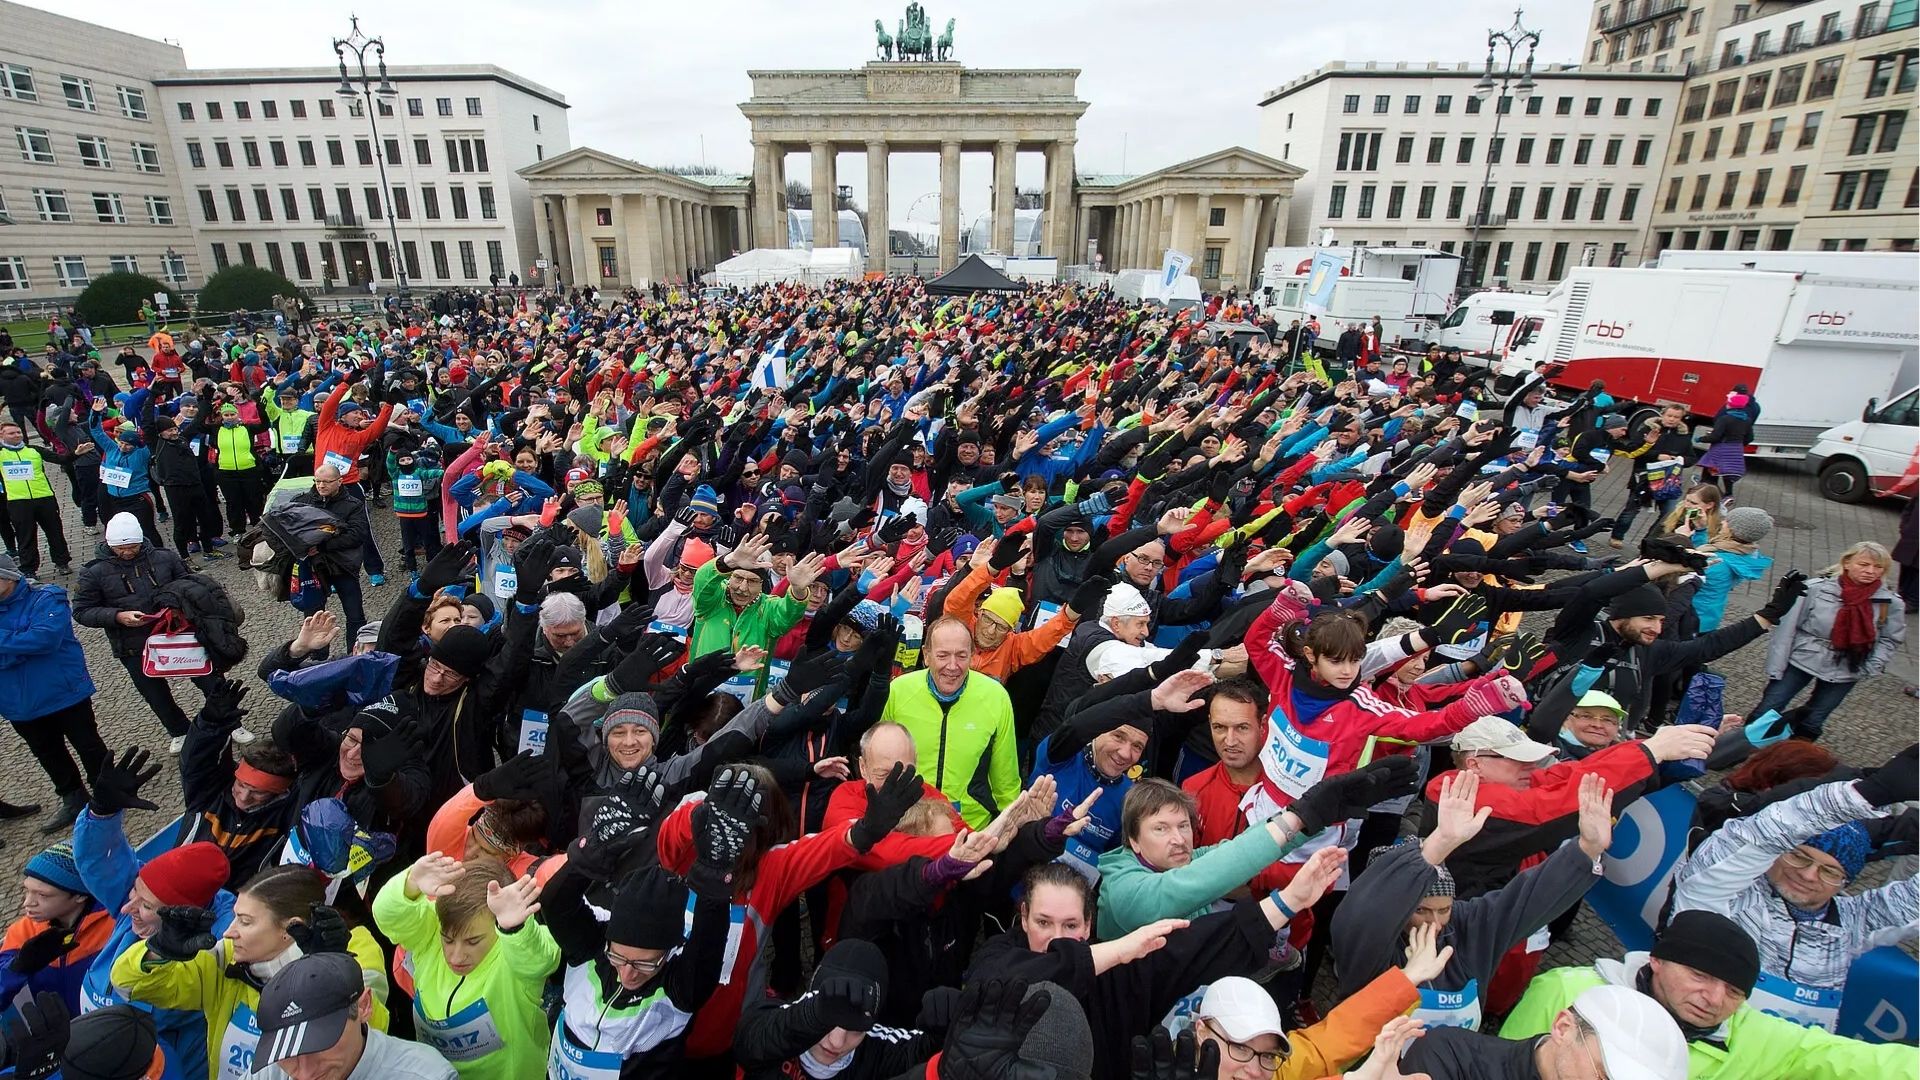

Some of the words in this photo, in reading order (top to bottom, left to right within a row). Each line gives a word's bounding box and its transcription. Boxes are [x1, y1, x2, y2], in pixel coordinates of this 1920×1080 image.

[1805, 310, 1846, 326] rbb
[1585, 319, 1624, 339] rbb
[501, 579, 516, 588] 20
[172, 656, 203, 664] Miami
[528, 730, 546, 743] 20
[1286, 724, 1303, 743] DKB
[1272, 735, 1311, 779] 2017
[1075, 845, 1092, 858] DKB
[92, 992, 113, 1006] DKB
[1438, 993, 1463, 1005] DKB
[1795, 987, 1819, 1001] DKB
[1174, 996, 1204, 1017] 20
[229, 1044, 255, 1069] 20
[563, 1039, 583, 1060] DKB
